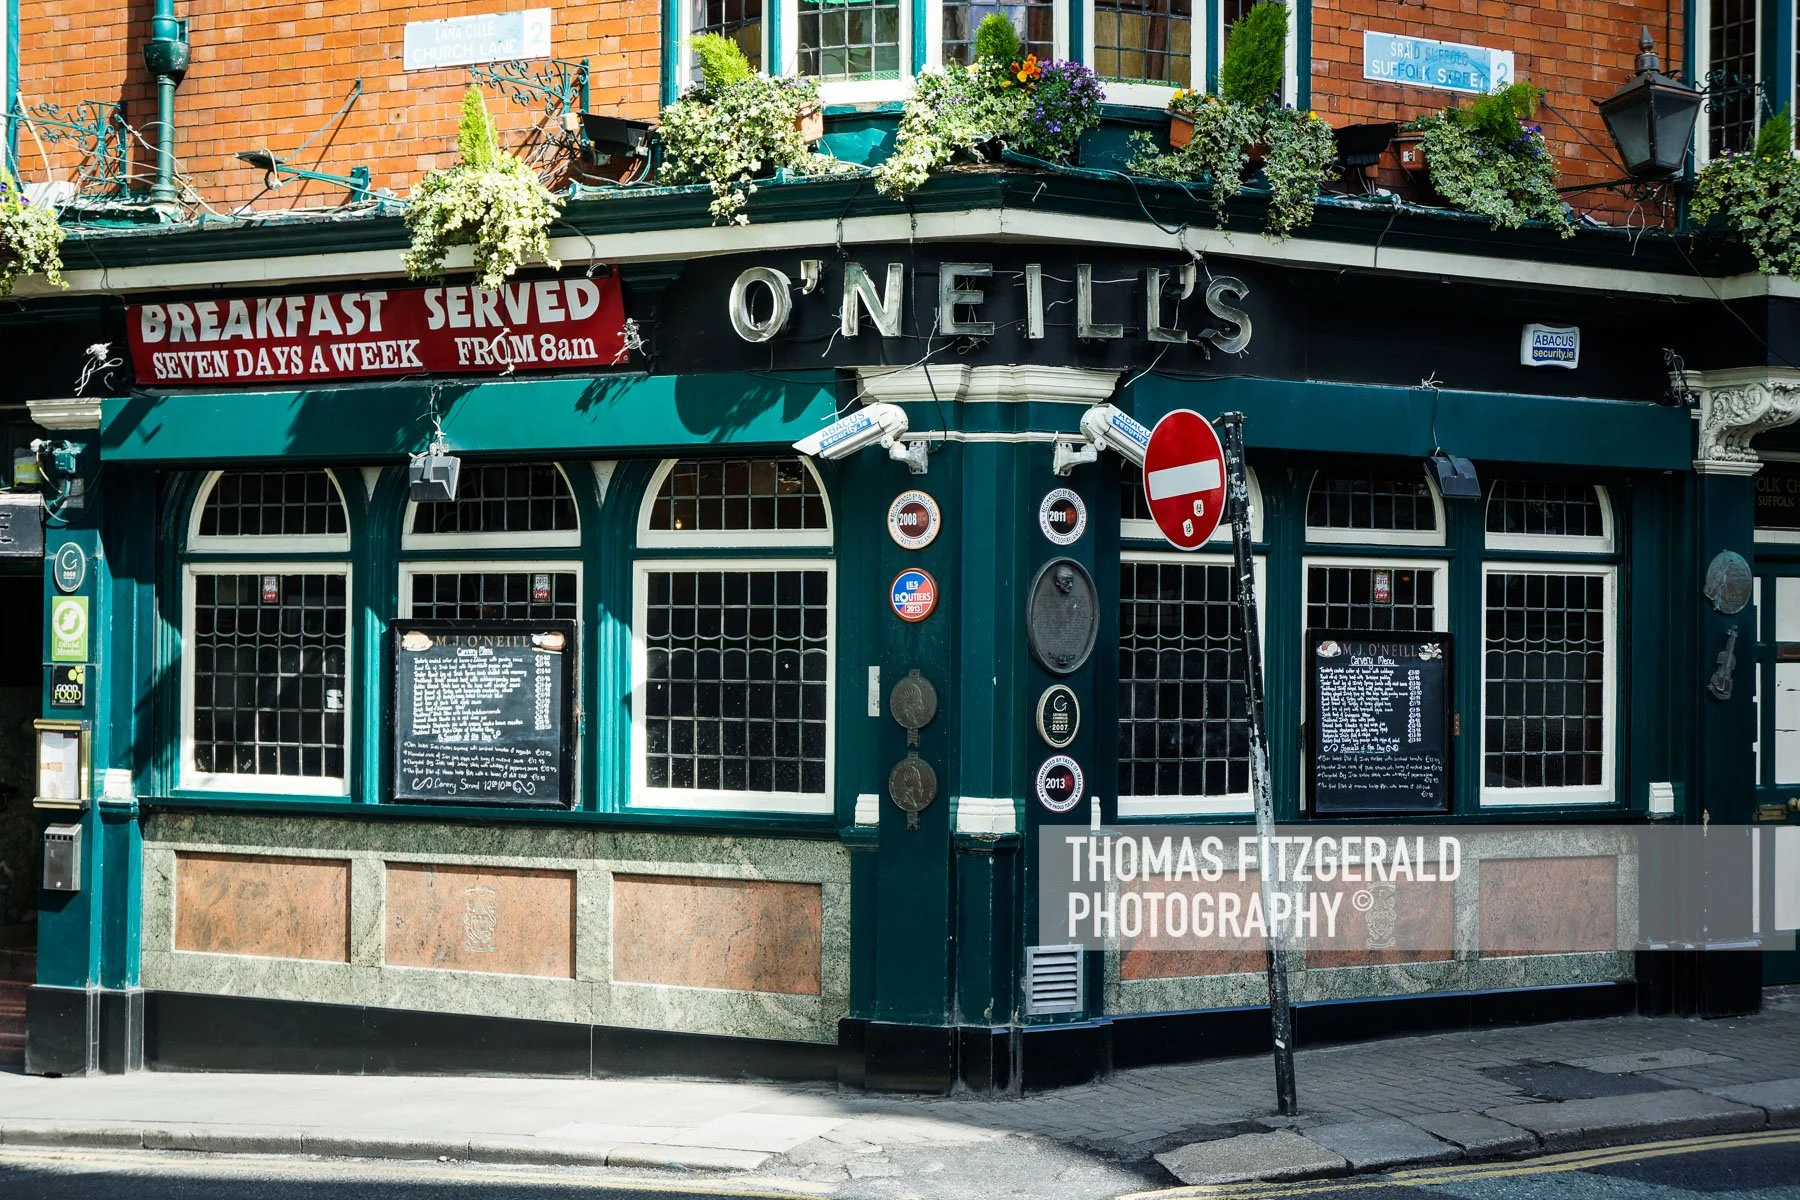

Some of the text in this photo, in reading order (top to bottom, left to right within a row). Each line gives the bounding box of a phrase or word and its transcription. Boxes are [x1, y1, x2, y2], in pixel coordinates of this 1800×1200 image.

[465, 22, 495, 39] CILLE
[530, 21, 544, 44] 2
[412, 37, 518, 63] CHURCH LANE
[1371, 59, 1486, 89] SUFFOLK STREET
[1496, 61, 1509, 85] 2
[141, 278, 600, 343] BREAKFAST SERVED
[728, 259, 1252, 354] O'NEILL'S
[1534, 334, 1575, 347] ABACUS
[153, 333, 598, 379] SEVEN DAYS A WEEK FROM 8am
[1533, 349, 1575, 361] security.ie
[822, 410, 865, 440] ABACUS
[823, 419, 869, 447] security.ie
[1757, 495, 1795, 508] SUFFOLK
[900, 513, 917, 526] 2008
[1049, 510, 1067, 522] 2011
[906, 580, 918, 590] LES
[894, 592, 931, 602] ROUTIERS
[906, 605, 921, 613] 2013
[467, 635, 530, 649] O'NEILL
[1368, 643, 1418, 657] O'NEILL
[1350, 656, 1395, 670] Carvery Menu
[54, 690, 82, 700] FOOD
[1038, 758, 1055, 793] RECOMMENDED
[1045, 778, 1065, 789] 2013
